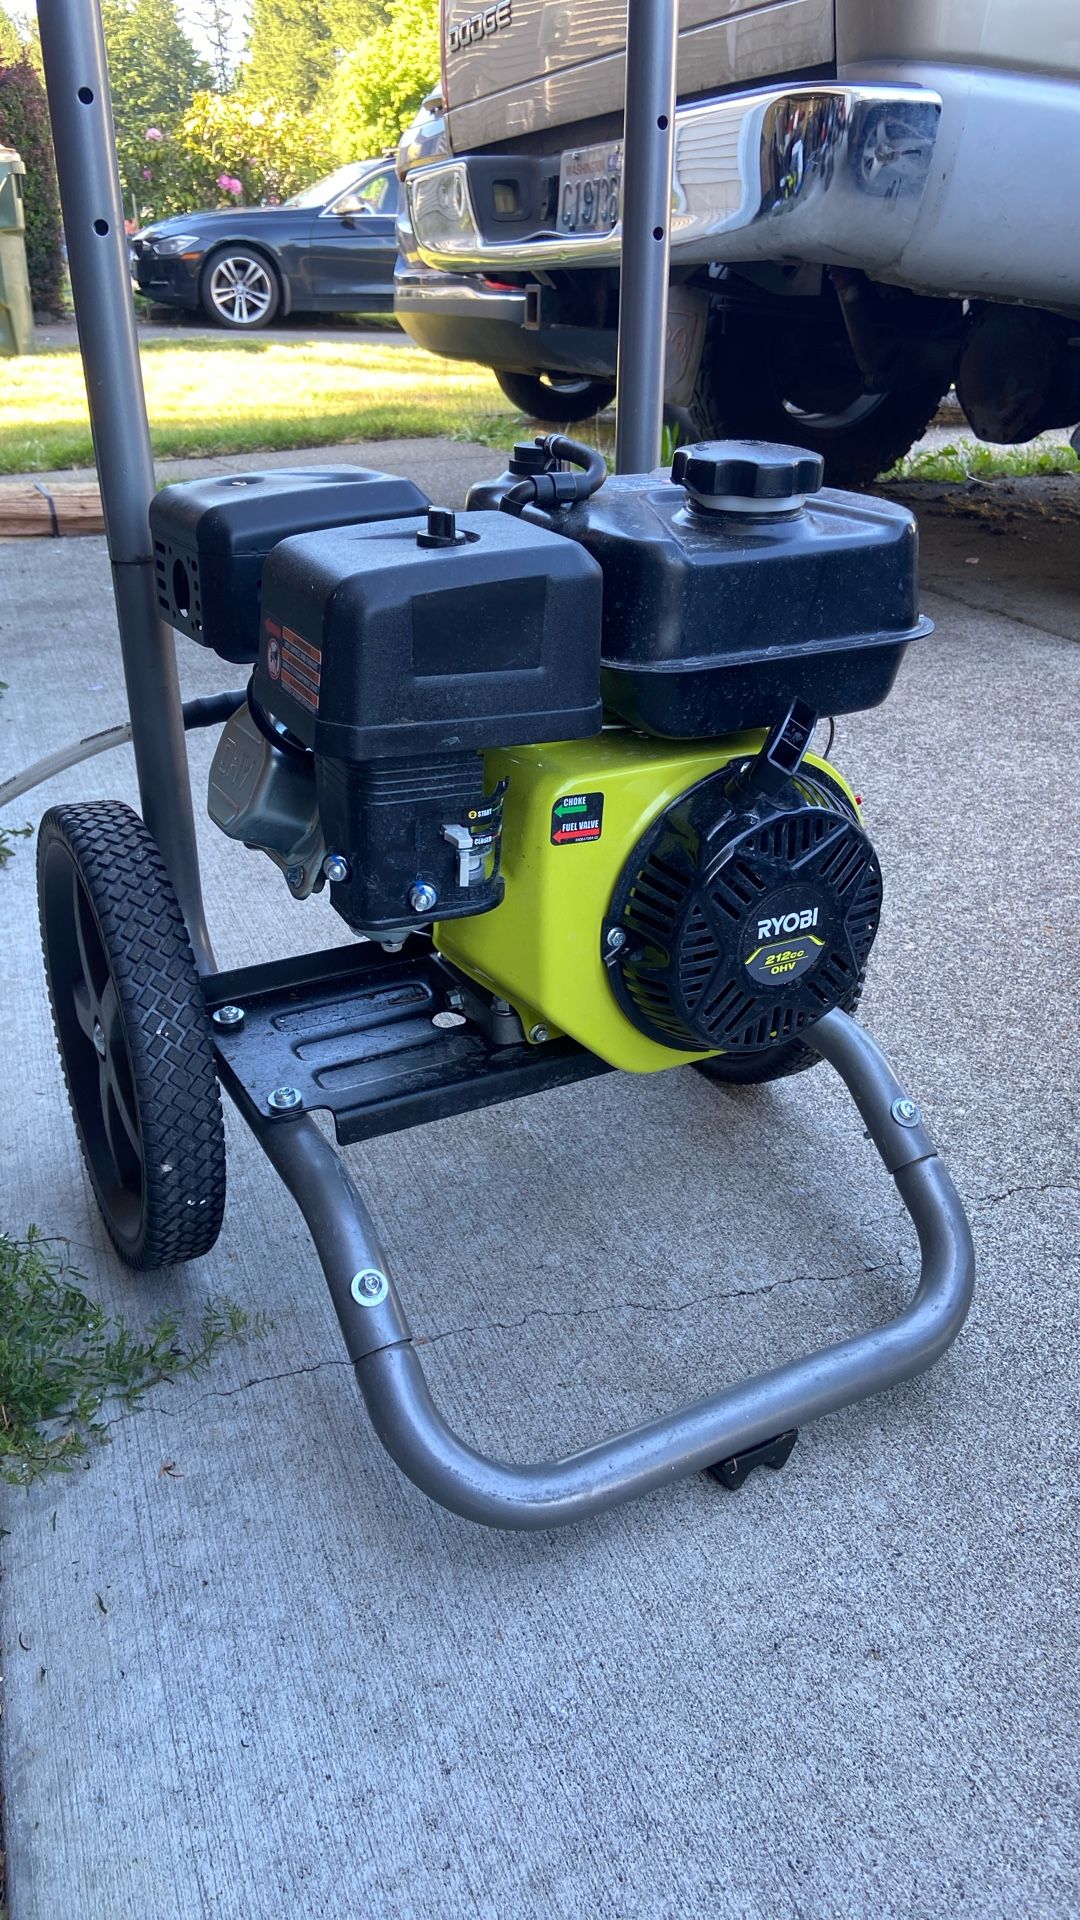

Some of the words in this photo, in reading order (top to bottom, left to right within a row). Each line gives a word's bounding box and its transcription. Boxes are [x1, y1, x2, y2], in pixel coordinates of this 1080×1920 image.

[449, 0, 512, 51] DODGE
[564, 796, 586, 806] CHOKE
[478, 808, 492, 818] START
[562, 822, 578, 831] FUEL
[578, 820, 599, 830] VALVE
[474, 836, 492, 845] CLOSED
[757, 907, 819, 939] RYOBI
[764, 950, 805, 966] 212cc
[770, 962, 797, 975] OHV
